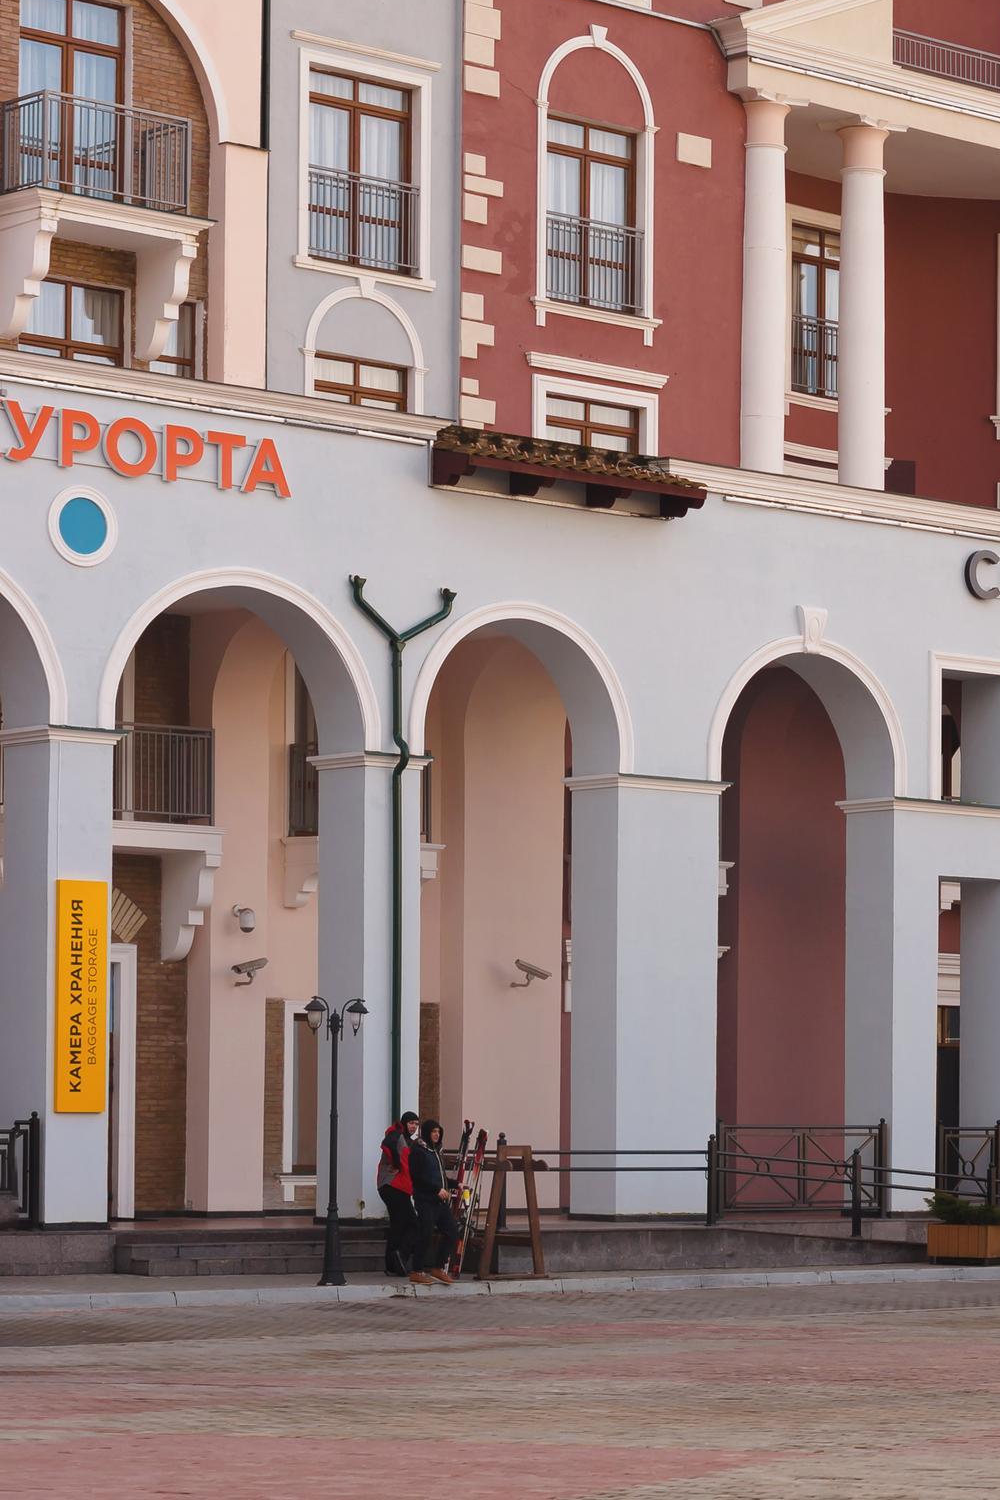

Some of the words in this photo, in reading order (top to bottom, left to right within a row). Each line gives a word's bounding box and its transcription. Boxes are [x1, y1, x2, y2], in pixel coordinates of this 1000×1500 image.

[0, 398, 292, 498] УРОРТА
[70, 899, 84, 1005] ХРАНЕНИЯ
[88, 928, 98, 993] STORAGE
[69, 1012, 82, 1093] КАМЕРА
[87, 997, 97, 1065] BAGGAGE
